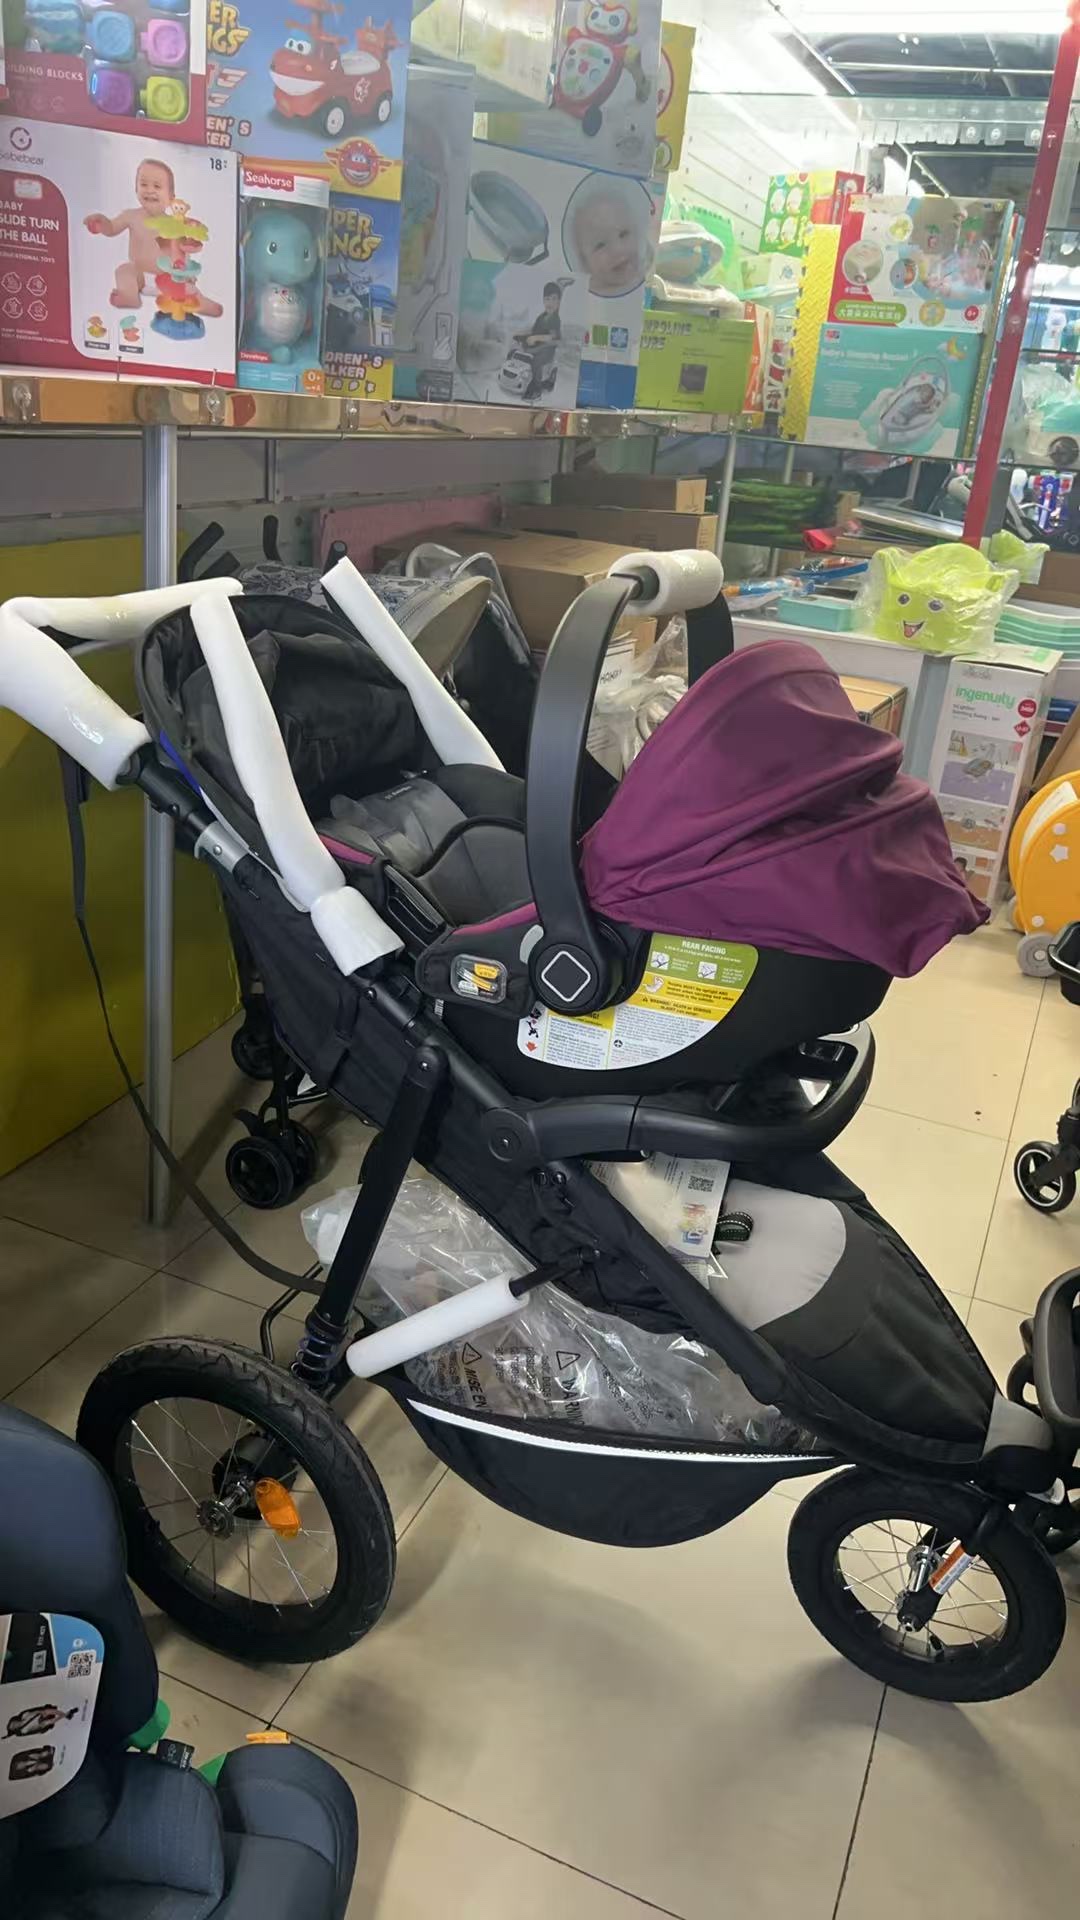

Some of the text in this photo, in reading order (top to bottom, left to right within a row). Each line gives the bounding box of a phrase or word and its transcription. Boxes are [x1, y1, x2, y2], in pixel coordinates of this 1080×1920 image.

[47, 68, 84, 82] BLOCKS
[246, 171, 292, 188] Seahorse
[29, 216, 60, 231] TURN
[21, 231, 48, 245] BALL
[956, 686, 1016, 710] ingenuity
[682, 940, 700, 950] REAR
[701, 944, 726, 955] FACING
[464, 1367, 487, 1408] MISE EN
